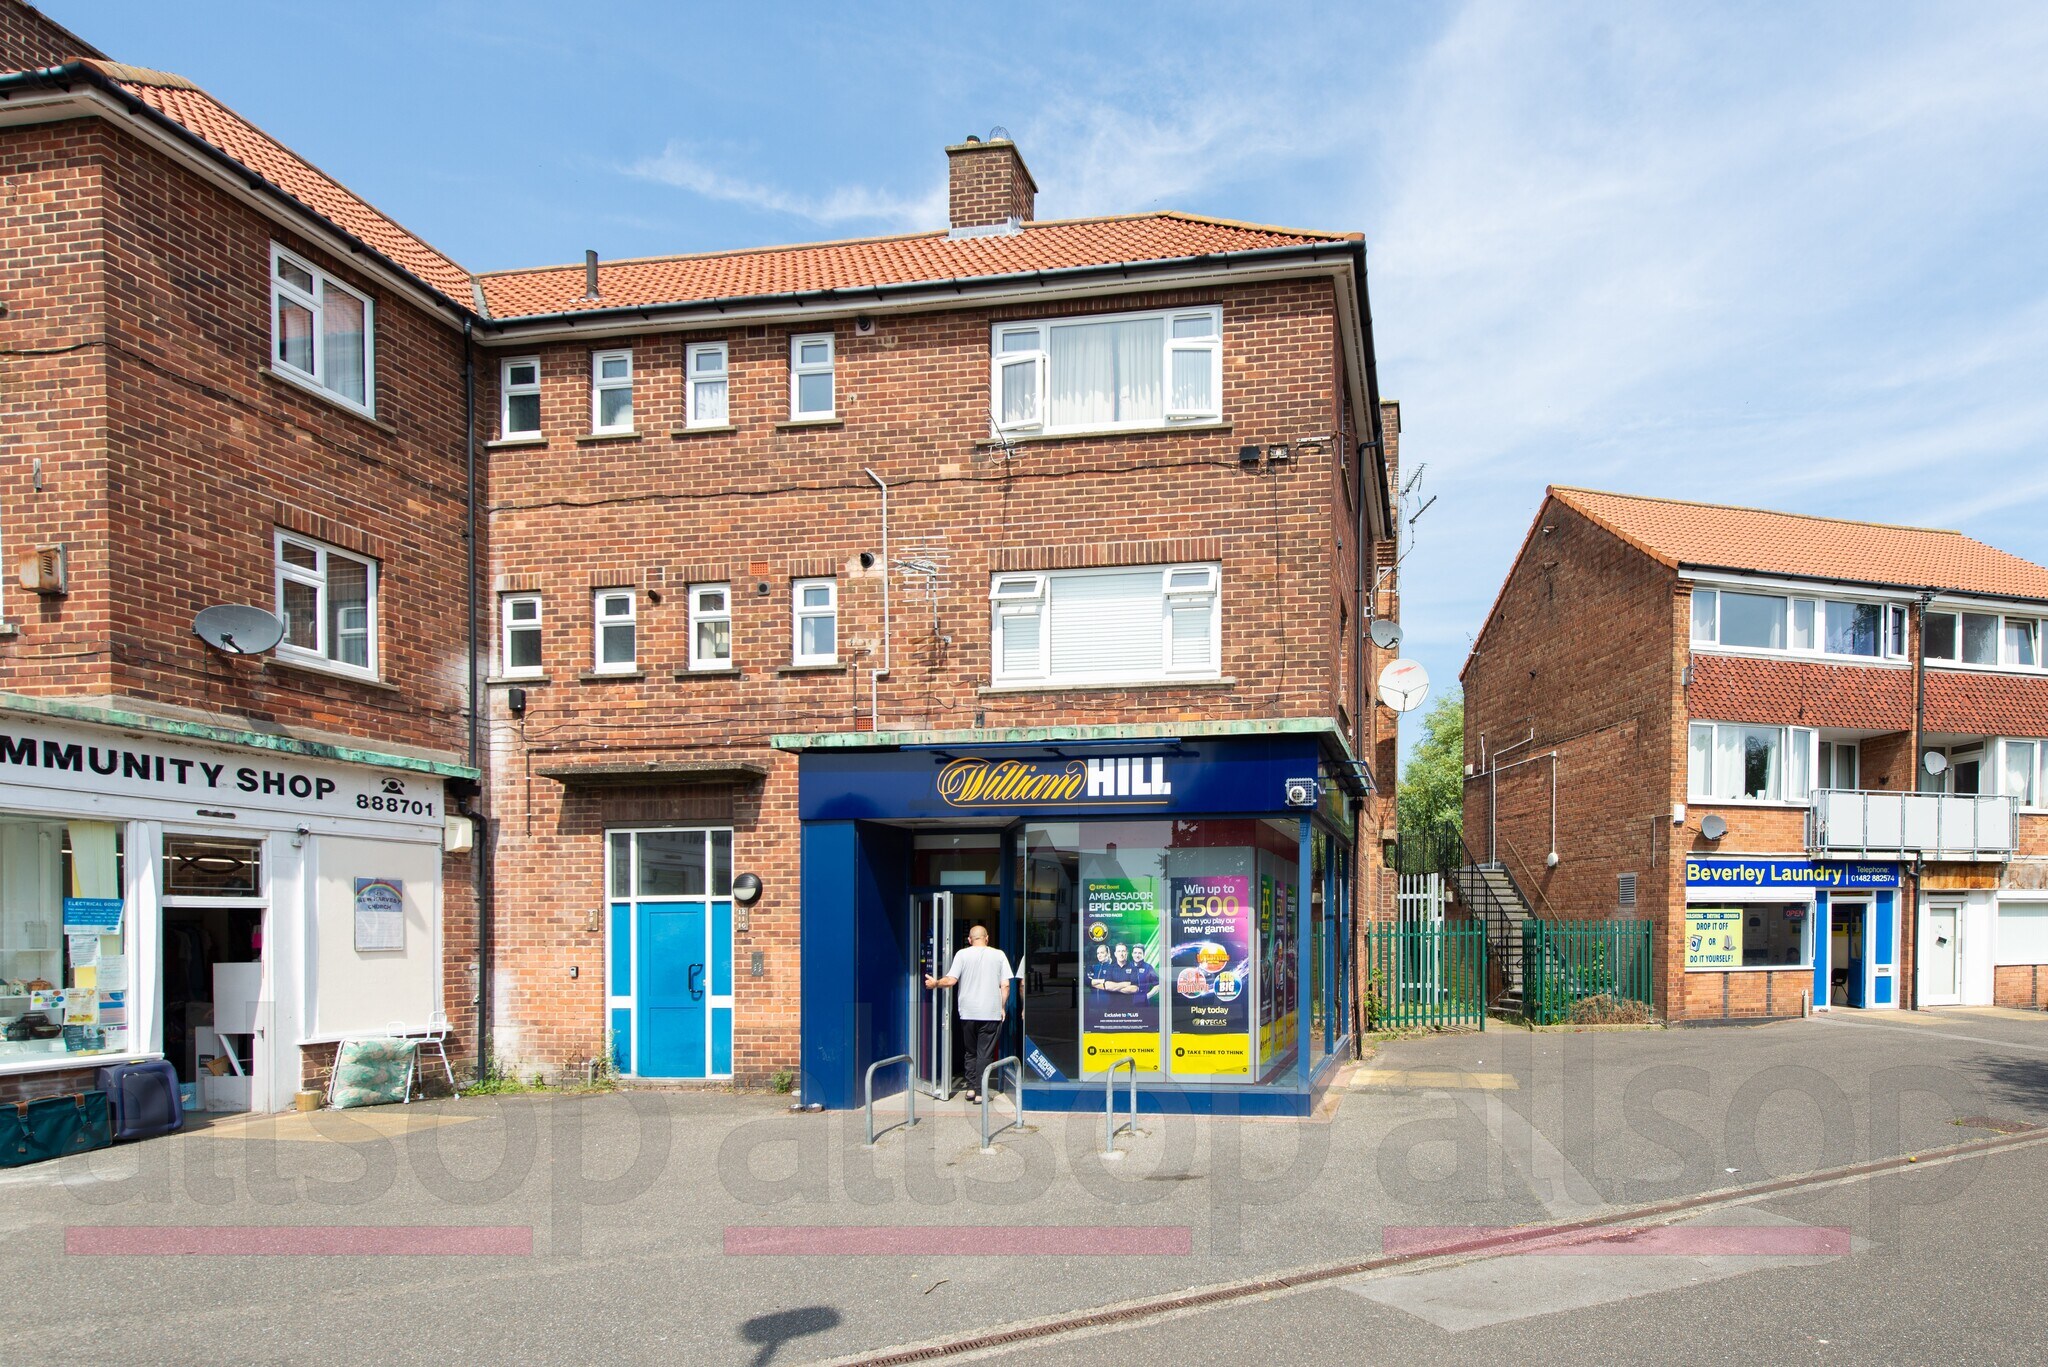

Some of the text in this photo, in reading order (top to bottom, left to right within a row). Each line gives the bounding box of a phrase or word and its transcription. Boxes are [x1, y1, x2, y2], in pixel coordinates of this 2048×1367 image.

[0, 735, 336, 800] MMUNITY SHOP
[937, 757, 1172, 803] William HILL
[356, 793, 433, 817] 888701
[1687, 863, 1843, 885] Beverley Laundry
[1856, 866, 1890, 874] Telephone:
[1183, 884, 1235, 896] Win up to
[1089, 892, 1154, 901] AMBASSADOR
[1089, 902, 1154, 912] EPIC BOOSTS
[1179, 896, 1239, 917] £500
[1786, 909, 1805, 917] OPEN
[1212, 918, 1225, 926] play
[1696, 922, 1729, 930] DROP IT OFF
[1184, 926, 1235, 935] new games
[1708, 938, 1717, 946] OR
[1690, 954, 1734, 963] DO IT YOURSELF!
[1219, 981, 1235, 992] BIG
[1190, 1006, 1229, 1015] Play today
